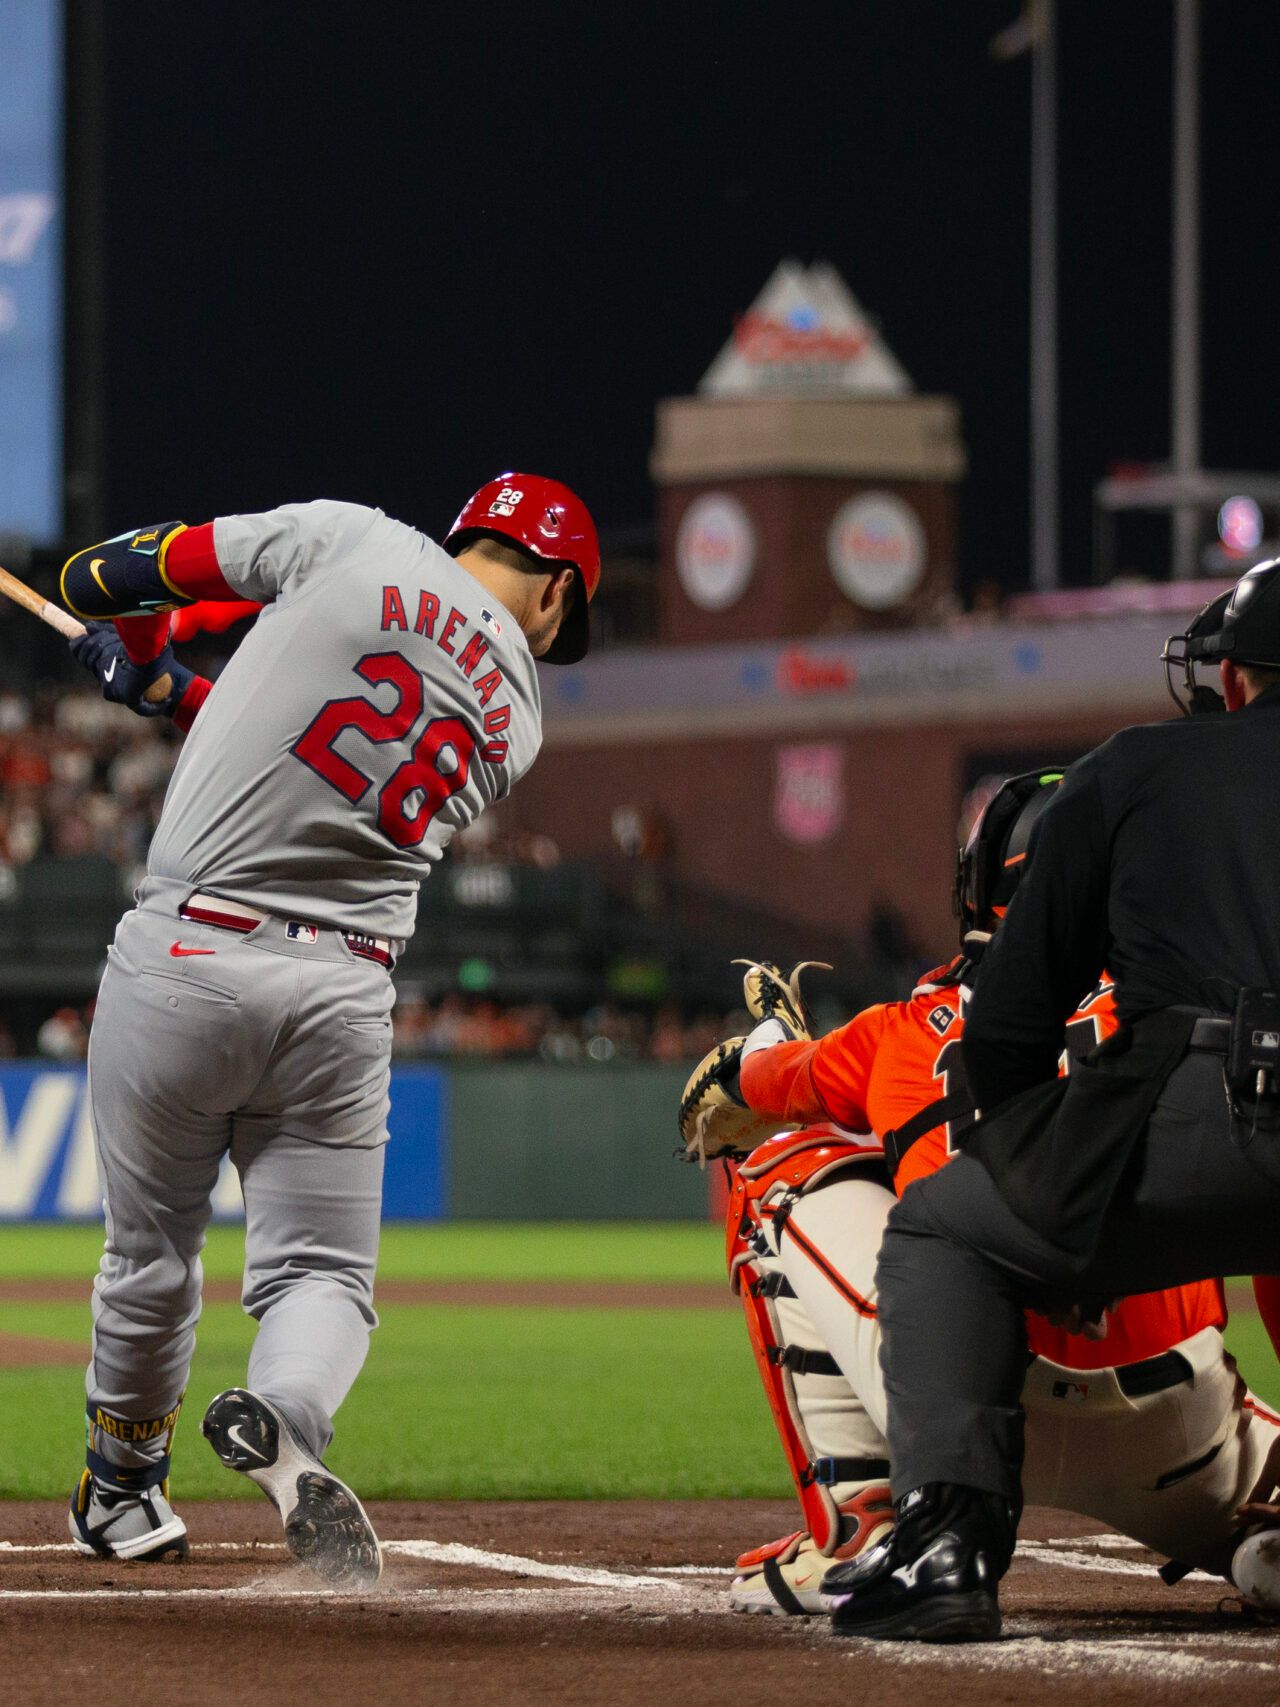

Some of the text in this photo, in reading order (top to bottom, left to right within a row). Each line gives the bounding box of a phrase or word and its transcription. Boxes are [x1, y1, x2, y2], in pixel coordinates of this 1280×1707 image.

[496, 488, 524, 505] 28
[288, 650, 476, 850] 28
[380, 585, 510, 765] ARENADO
